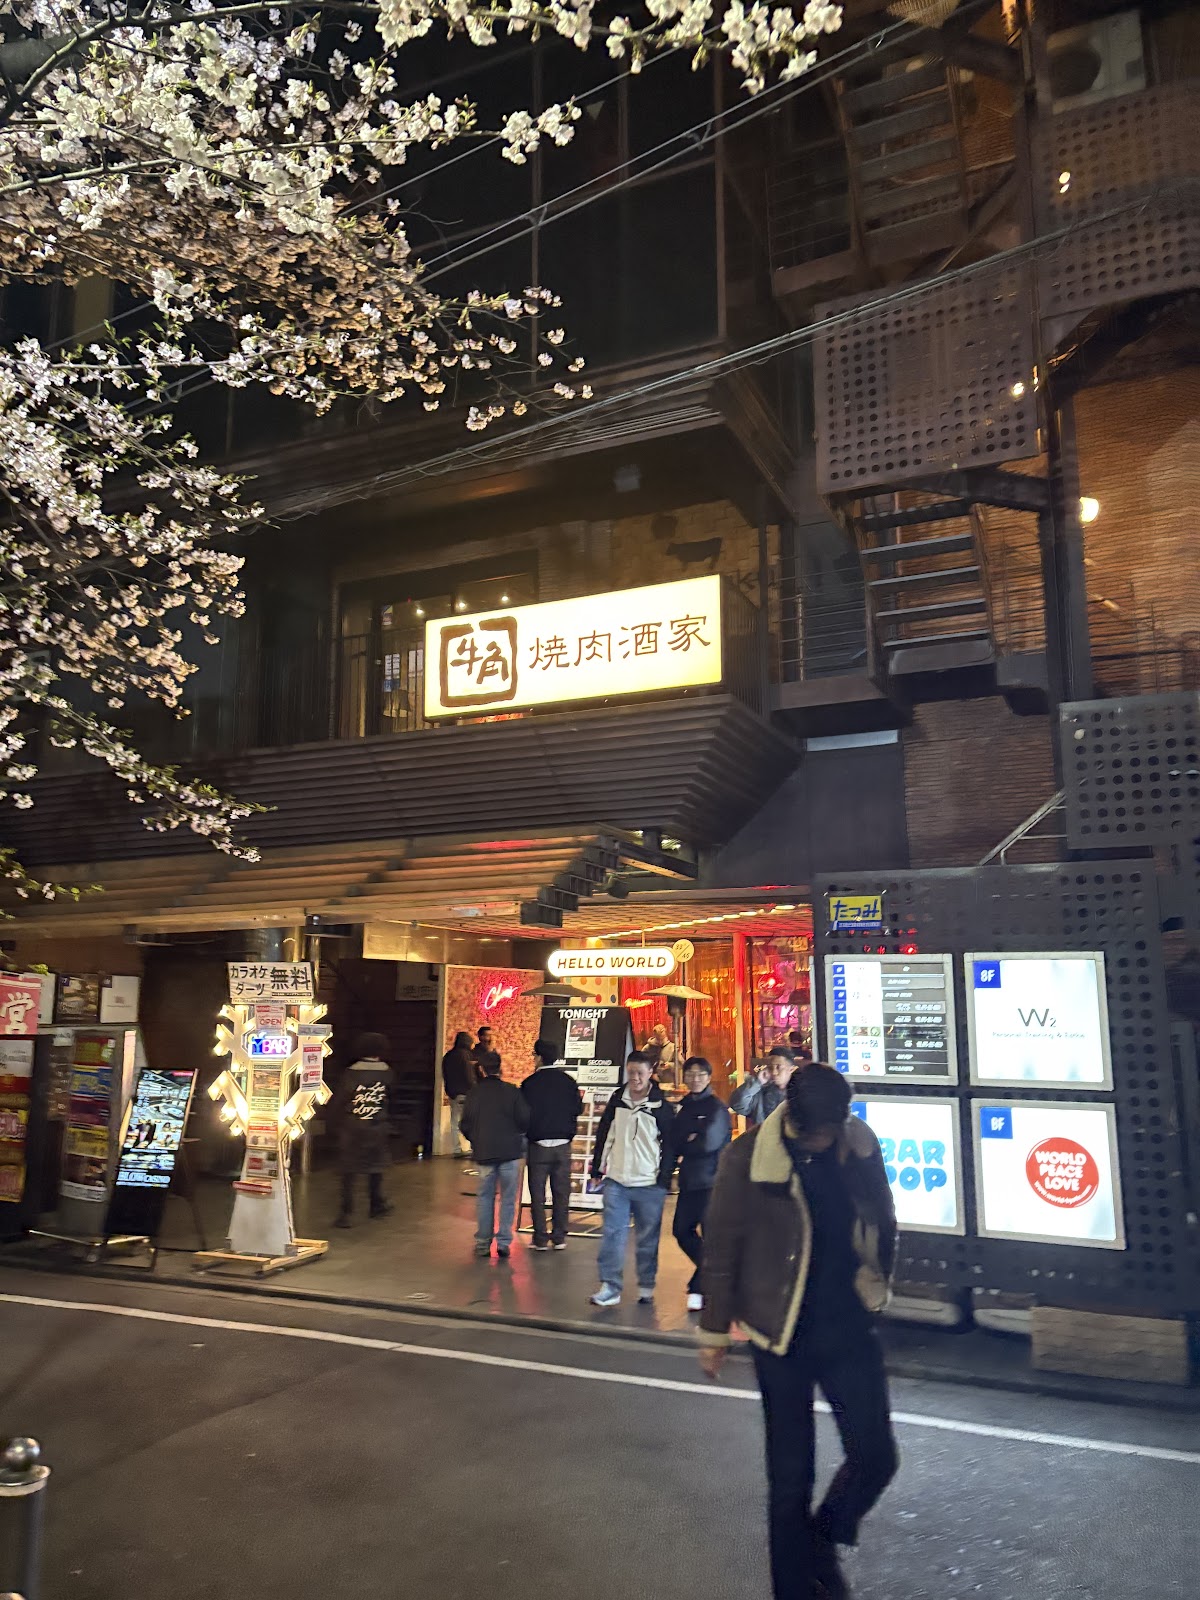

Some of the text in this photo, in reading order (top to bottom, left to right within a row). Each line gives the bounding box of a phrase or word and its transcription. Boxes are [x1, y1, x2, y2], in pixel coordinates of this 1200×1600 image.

[528, 613, 712, 671] 焼肉酒家
[450, 636, 509, 685] 牛角
[832, 898, 880, 921] たつみ
[557, 956, 667, 970] HELLO WORLD
[230, 965, 268, 979] カラオケ
[269, 966, 311, 991] 無料
[980, 969, 996, 982] 8F
[235, 982, 265, 996] ダーツ
[558, 1008, 609, 1019] TONIGHT
[259, 1018, 282, 1026] OPEN
[261, 1037, 288, 1055] BAR
[878, 1137, 946, 1166] BAR
[1034, 1150, 1087, 1166] WORLD
[1039, 1163, 1084, 1179] PEACE
[1044, 1176, 1080, 1191] LOVE
